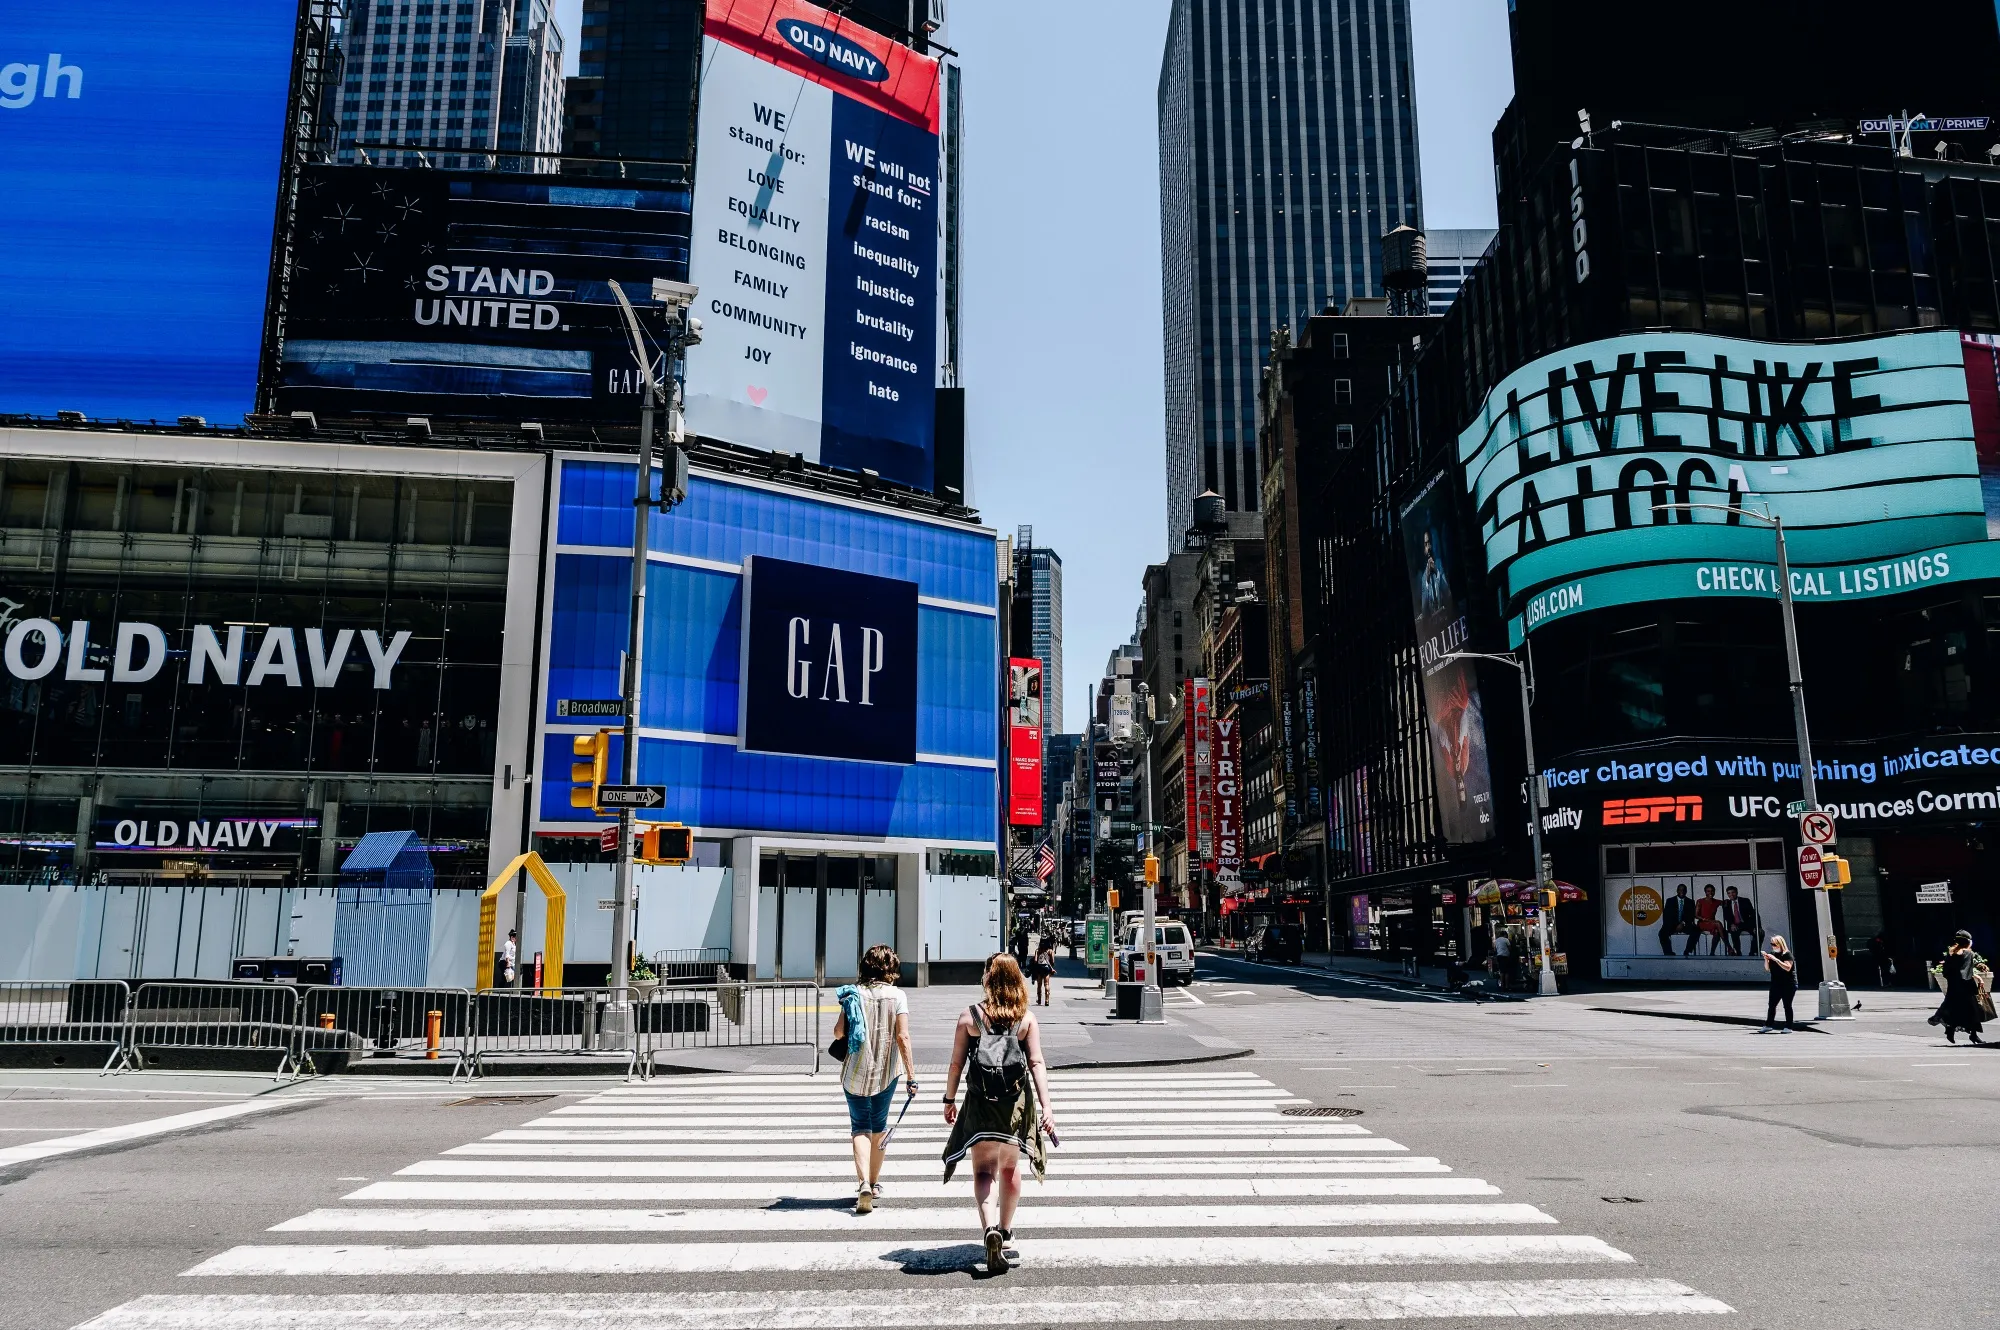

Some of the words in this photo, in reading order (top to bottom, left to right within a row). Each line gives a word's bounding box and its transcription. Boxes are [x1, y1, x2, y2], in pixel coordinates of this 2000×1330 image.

[789, 25, 825, 54] OLD
[829, 41, 878, 77] NAVY
[753, 102, 786, 132] WE
[1863, 119, 1938, 131] OUTFONT
[1946, 119, 1985, 129] PRIME
[728, 125, 774, 152] stand
[779, 143, 806, 165] for:
[748, 168, 785, 194] LOVE
[845, 139, 876, 169] WE
[879, 160, 904, 180] will
[908, 170, 931, 191] not
[852, 174, 894, 200] stand
[897, 189, 922, 211] for:
[728, 197, 801, 233] EQUALITY
[865, 213, 910, 240] racism
[1569, 158, 1589, 283] 1500
[718, 229, 807, 271] BELONGING
[853, 241, 920, 277] inequality
[425, 264, 555, 295] STAND
[734, 270, 790, 299] FAMILY
[856, 276, 915, 307] injustice
[414, 298, 570, 331] UNITED.
[710, 299, 807, 341] COMMUNITY
[856, 309, 914, 341] brutality
[744, 345, 773, 365] JOY
[850, 341, 918, 374] ignorance
[608, 368, 645, 394] GAP
[868, 381, 900, 402] hate
[1507, 351, 1687, 469] LIVE
[1708, 354, 1881, 458] LIKE
[1697, 567, 1767, 591] CHECK
[1771, 570, 1831, 596] LCAL
[1840, 553, 1950, 594] LISTINGS
[4, 618, 168, 683] OLD
[187, 624, 413, 690] NAVY
[1419, 637, 1440, 669] FOR
[1440, 615, 1469, 656] LIFE
[787, 617, 884, 706] GAP
[1230, 682, 1268, 701] VIRGIL'S
[571, 701, 621, 716] Broadway
[1197, 688, 1208, 742] PARK
[1597, 756, 1708, 784] charged
[1715, 754, 1767, 778] with
[607, 792, 627, 802] ONE
[635, 792, 655, 802] WAY
[1199, 776, 1210, 831] PARK
[1217, 720, 1238, 856] VIRGILS
[1602, 796, 1703, 826] ESPN
[1728, 796, 1781, 819] UFC
[114, 820, 180, 847] OLD
[187, 821, 280, 848] NAVY
[1218, 857, 1240, 865] BBQ
[1809, 853, 1818, 861] NOT
[1805, 872, 1819, 880] ENTER
